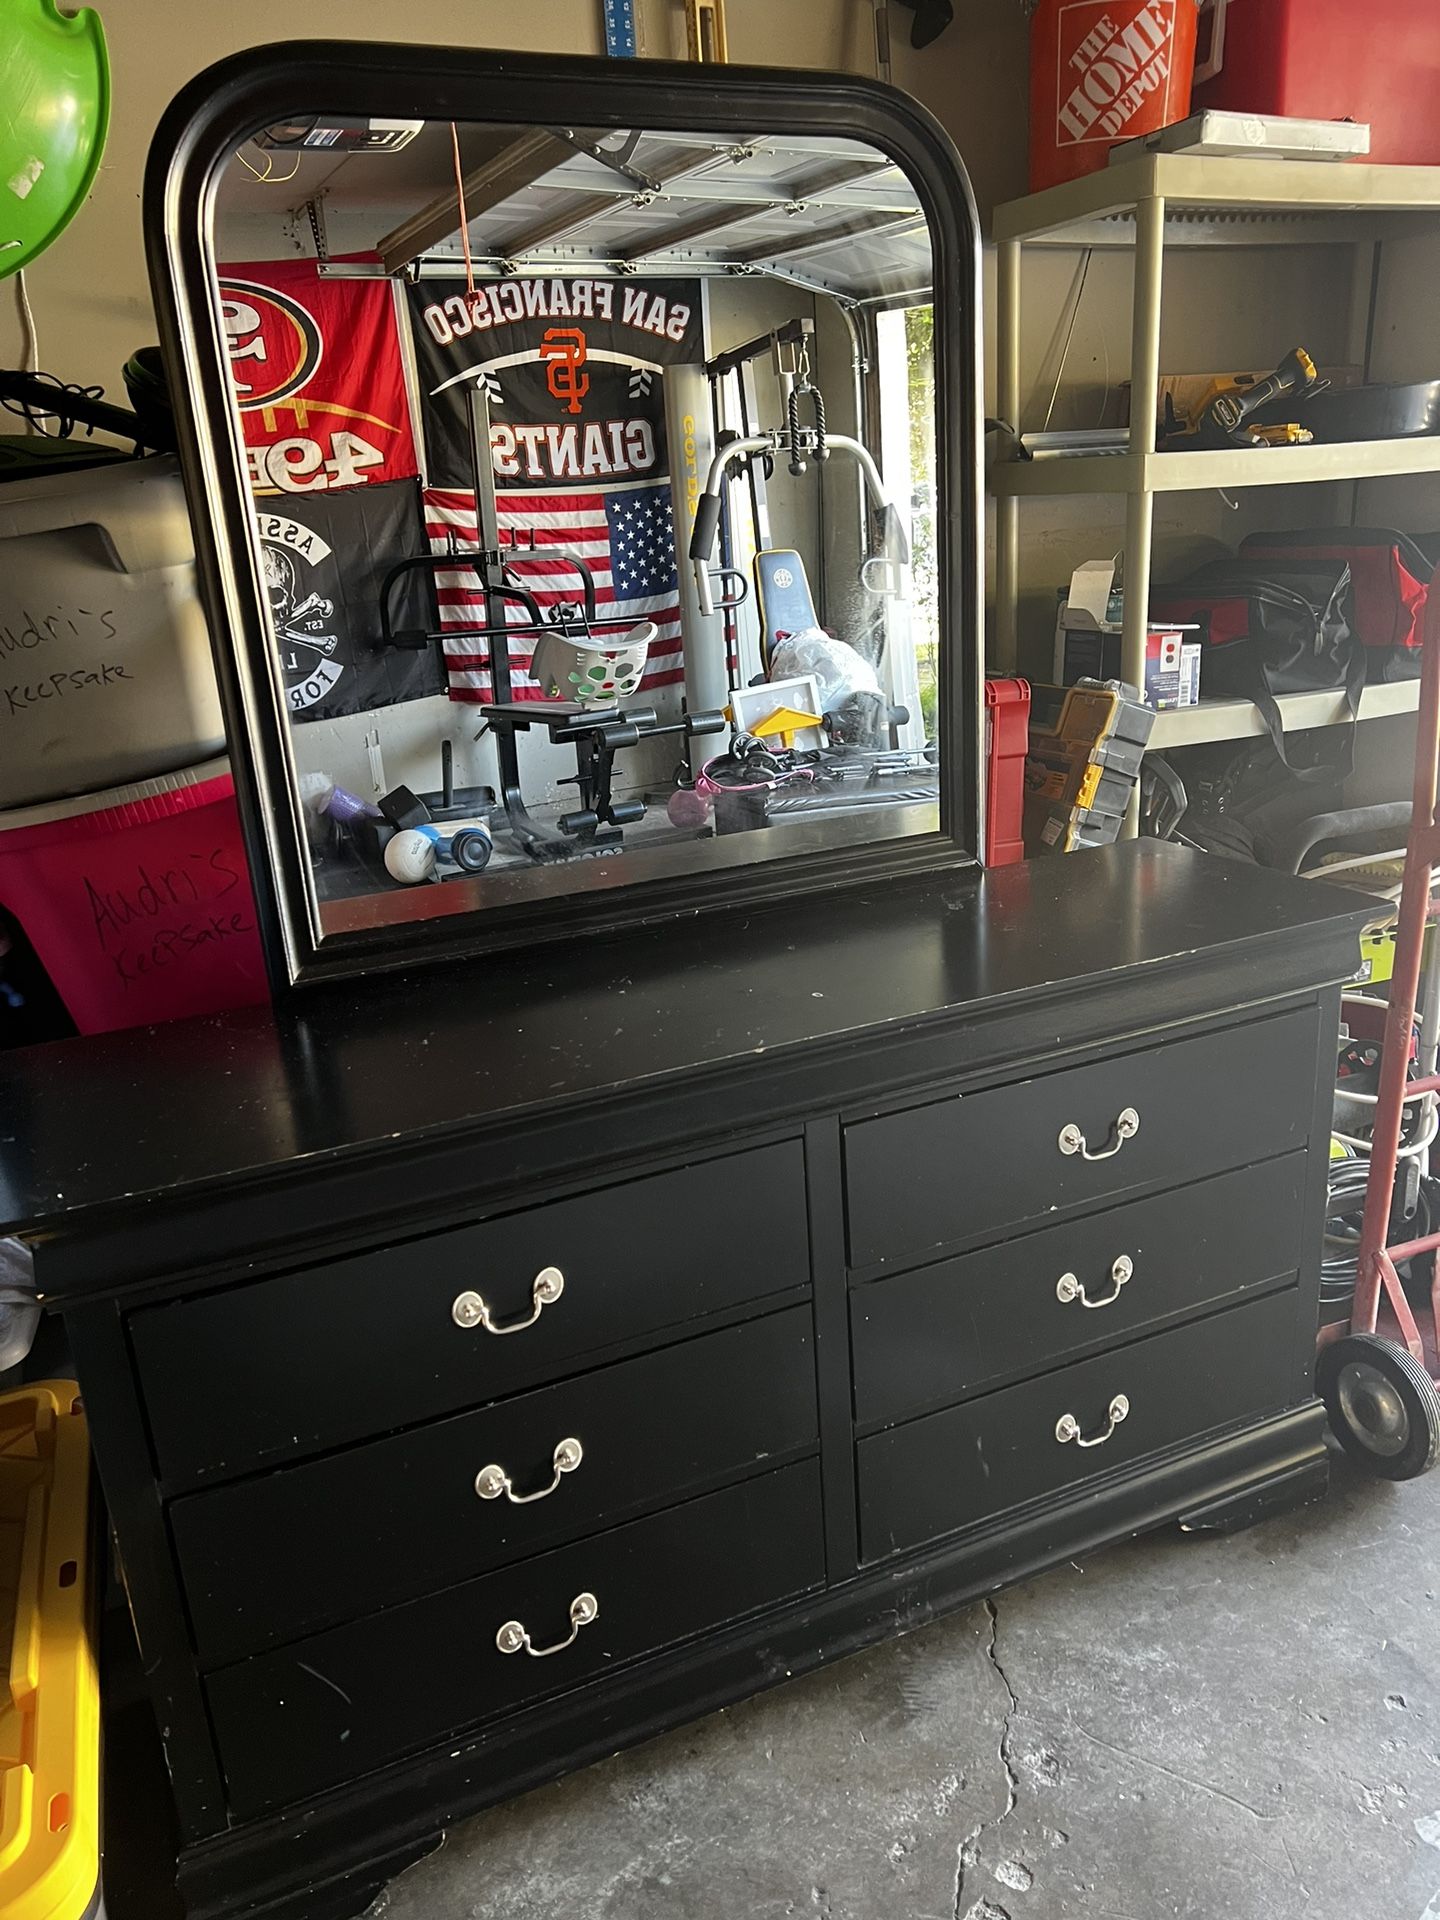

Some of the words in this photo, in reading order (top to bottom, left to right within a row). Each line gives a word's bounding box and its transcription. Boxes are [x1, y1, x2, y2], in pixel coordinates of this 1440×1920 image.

[626, 38, 632, 47] 14
[1058, 0, 1173, 141] HOME
[1068, 14, 1120, 73] THE
[1099, 52, 1170, 137] DEPOT
